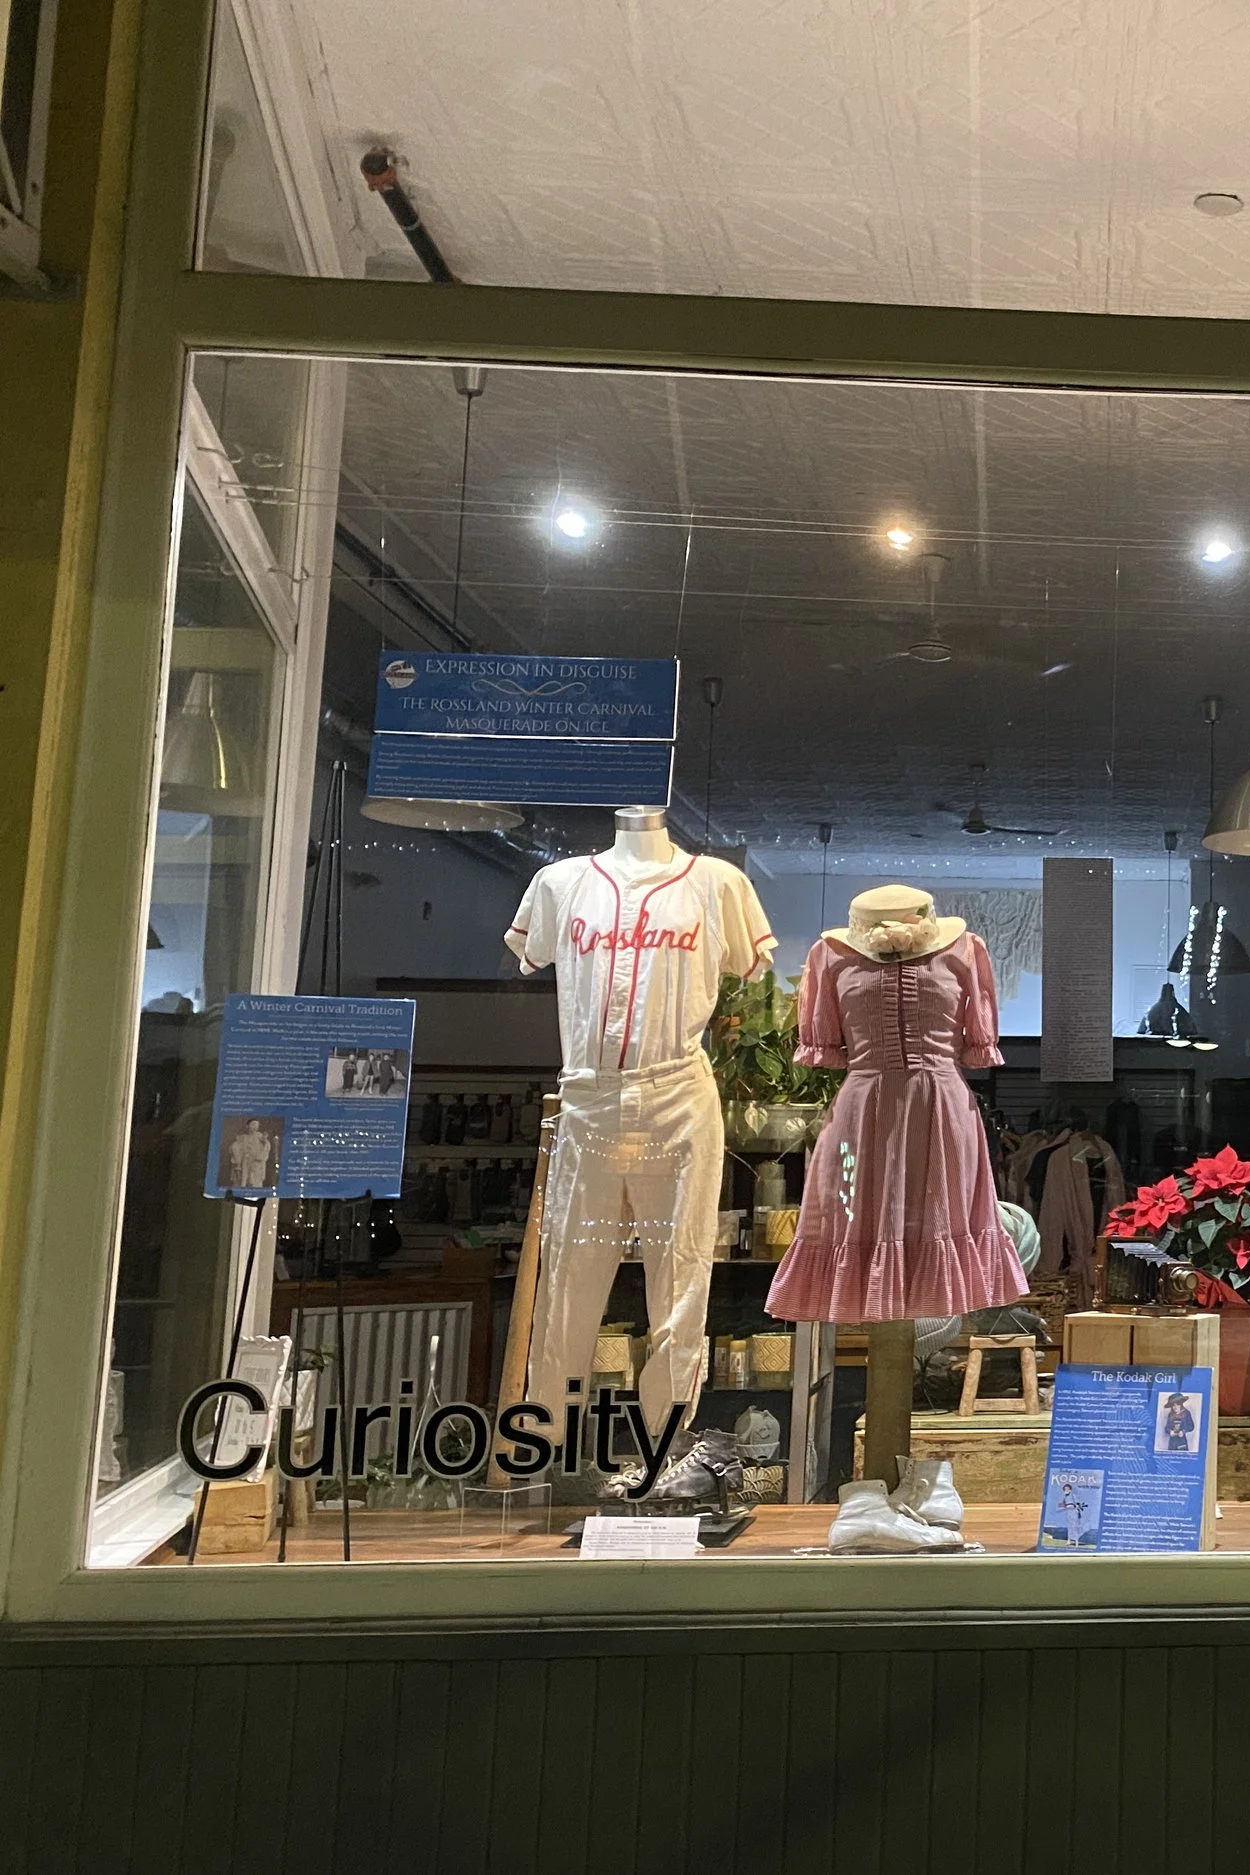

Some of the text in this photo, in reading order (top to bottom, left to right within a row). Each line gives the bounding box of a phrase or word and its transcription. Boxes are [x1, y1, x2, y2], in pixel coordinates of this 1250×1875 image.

[425, 659, 638, 679] EXPRESSION IN DISGUISE
[400, 697, 655, 716] THE ROSSLAND WINTER CARNIVAL
[445, 717, 610, 734] MASQUERADE ON ICE
[571, 907, 700, 955] Rossland
[236, 1000, 403, 1016] A Winter Carnival Tradition
[1092, 1370, 1176, 1384] The Kodak Girl
[178, 1376, 688, 1503] Curiosity
[1050, 1474, 1097, 1486] KODAK
